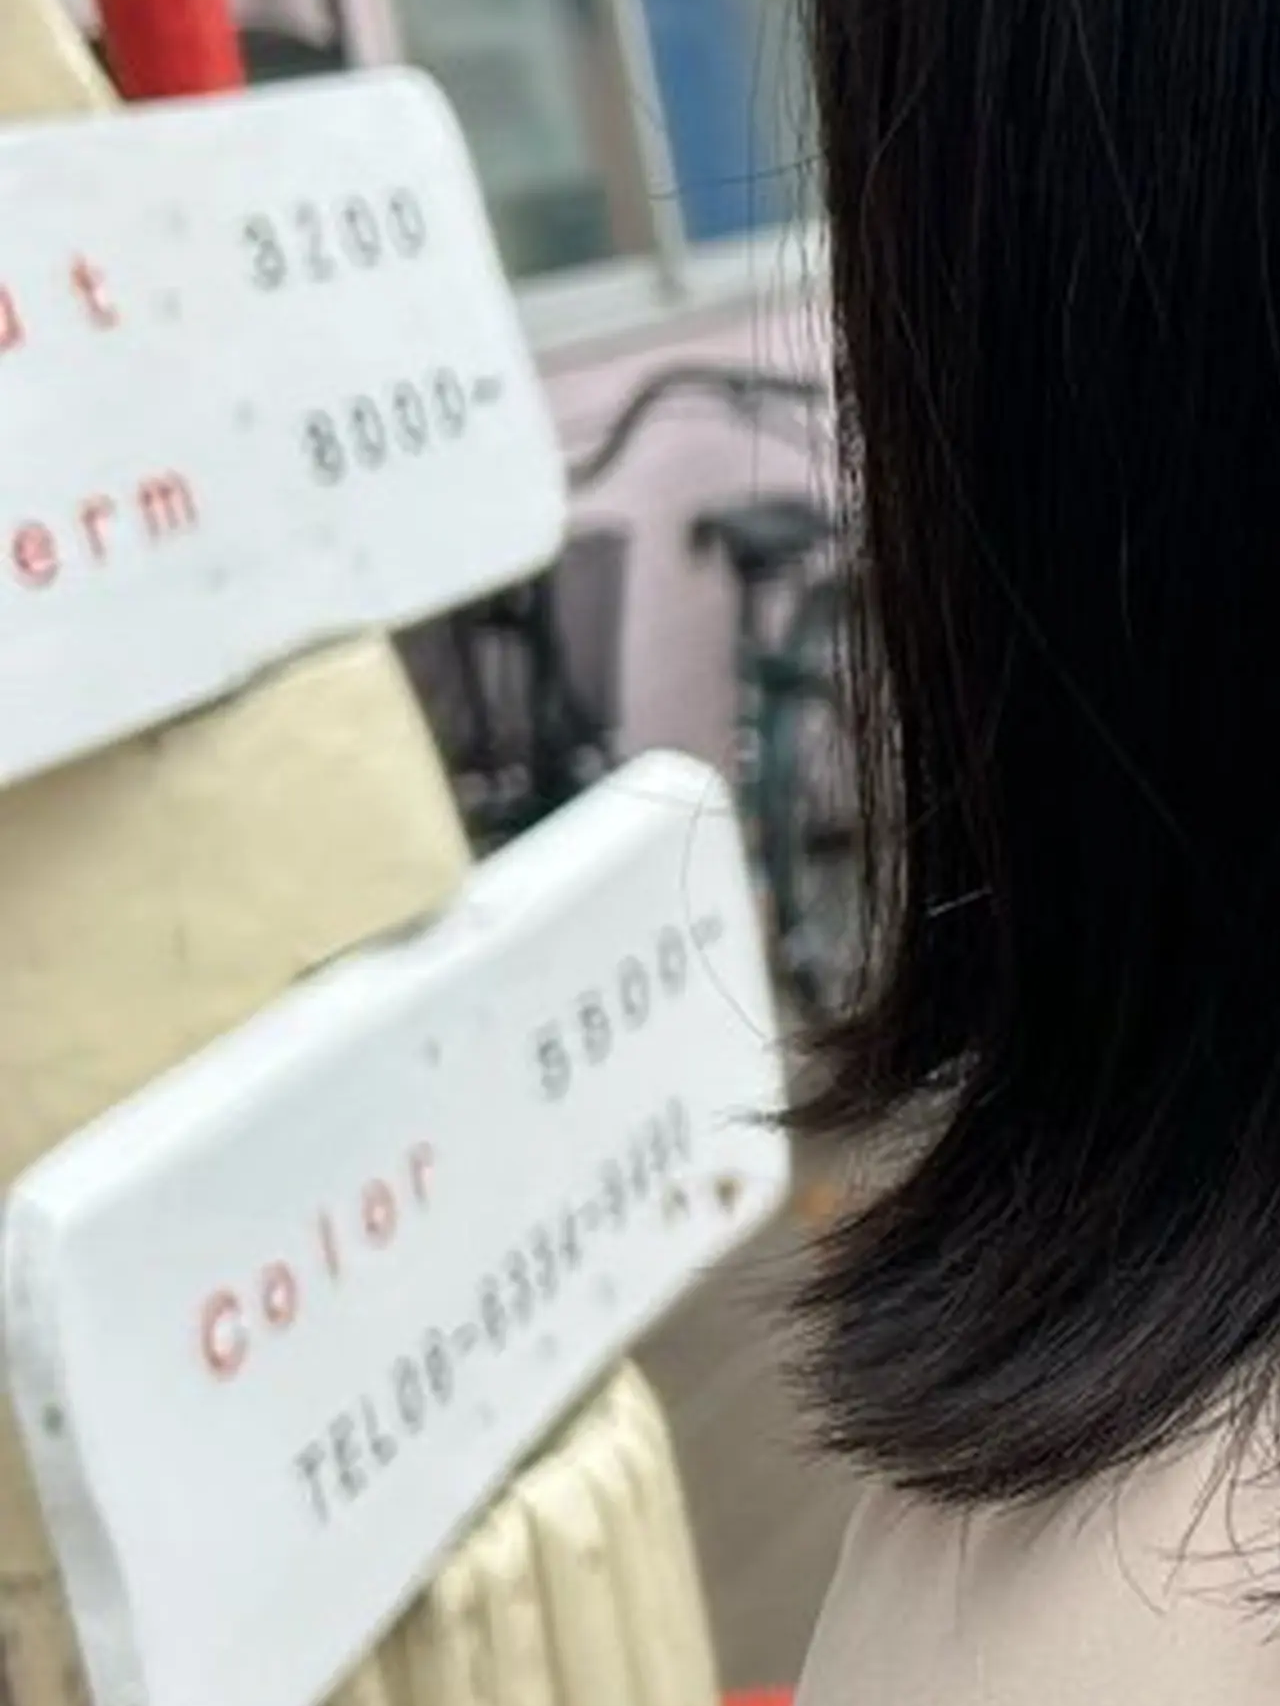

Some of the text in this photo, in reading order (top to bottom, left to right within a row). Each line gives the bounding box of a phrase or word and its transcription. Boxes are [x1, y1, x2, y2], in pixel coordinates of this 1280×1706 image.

[243, 187, 428, 290] 3200
[13, 469, 199, 589] erm
[199, 1143, 438, 1379] Color
